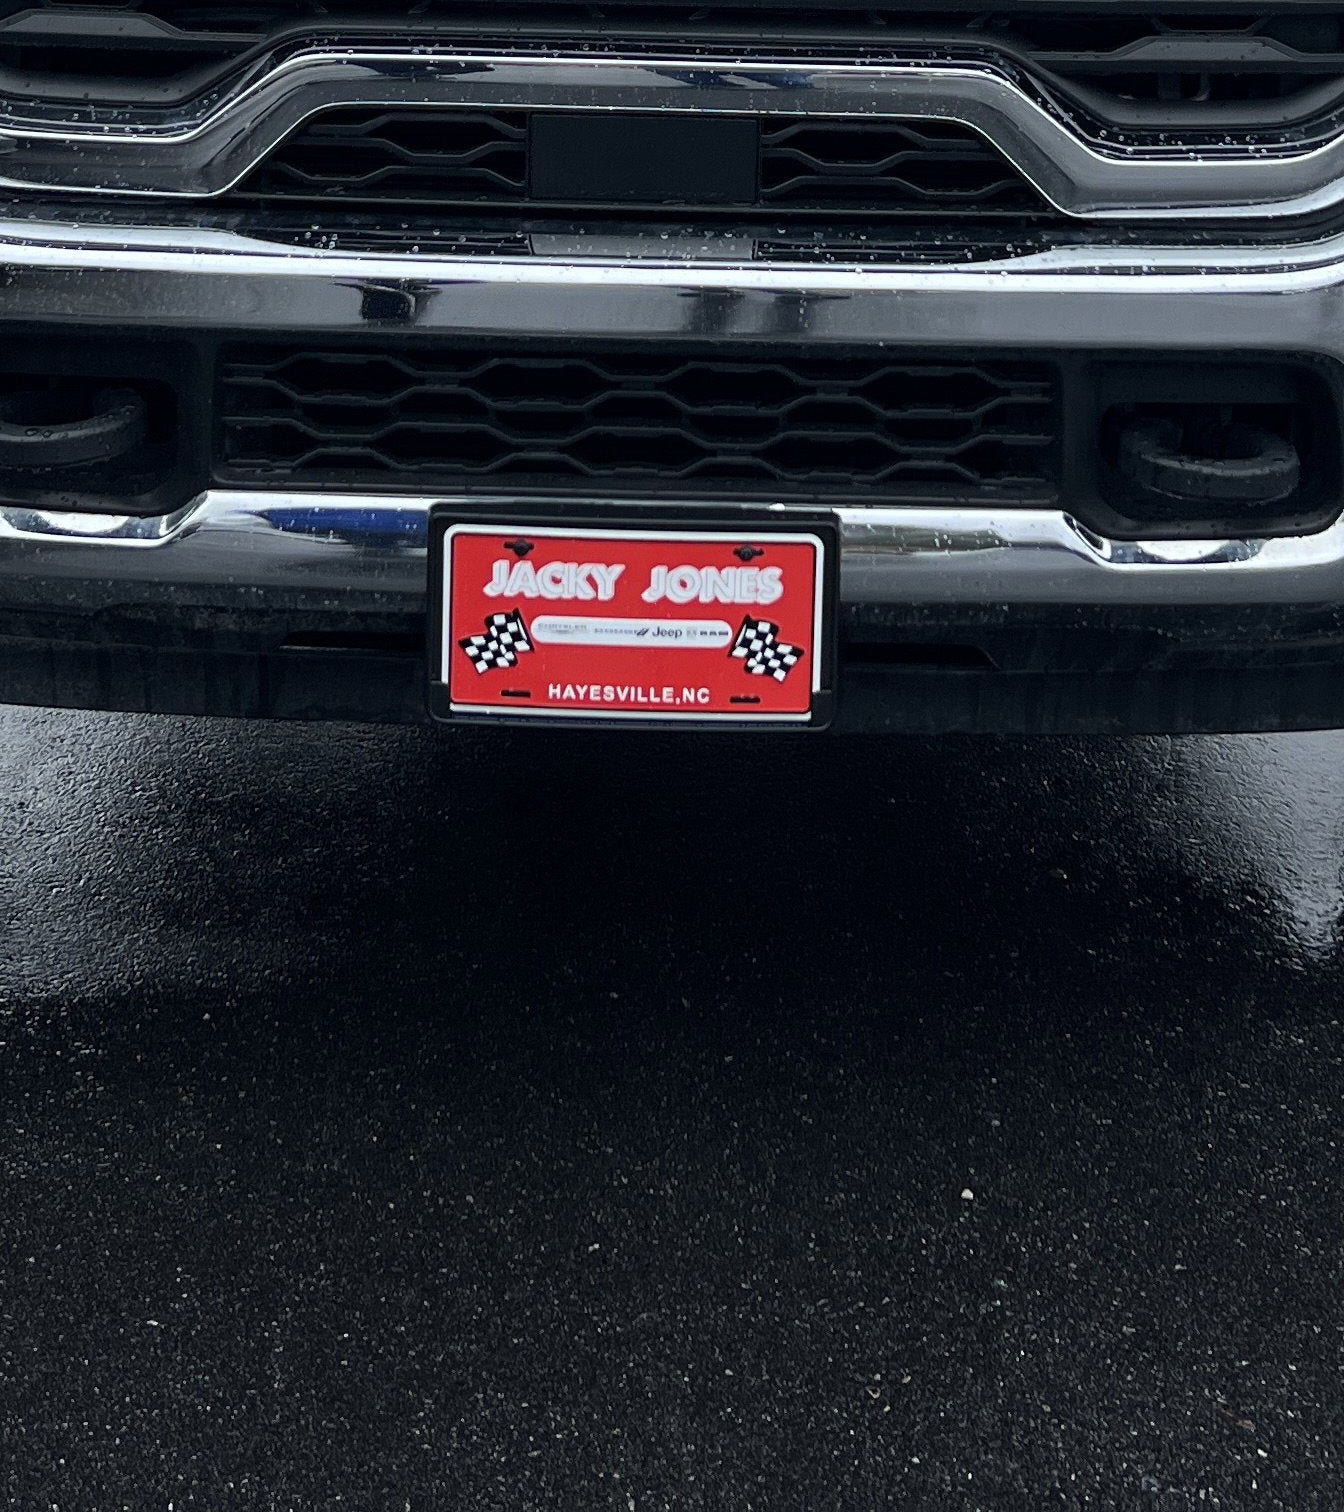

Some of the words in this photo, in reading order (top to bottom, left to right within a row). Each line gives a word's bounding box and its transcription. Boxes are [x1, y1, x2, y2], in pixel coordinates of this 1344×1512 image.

[482, 559, 626, 602] JACKY
[641, 565, 784, 605] JONES
[651, 625, 683, 640] Jeep
